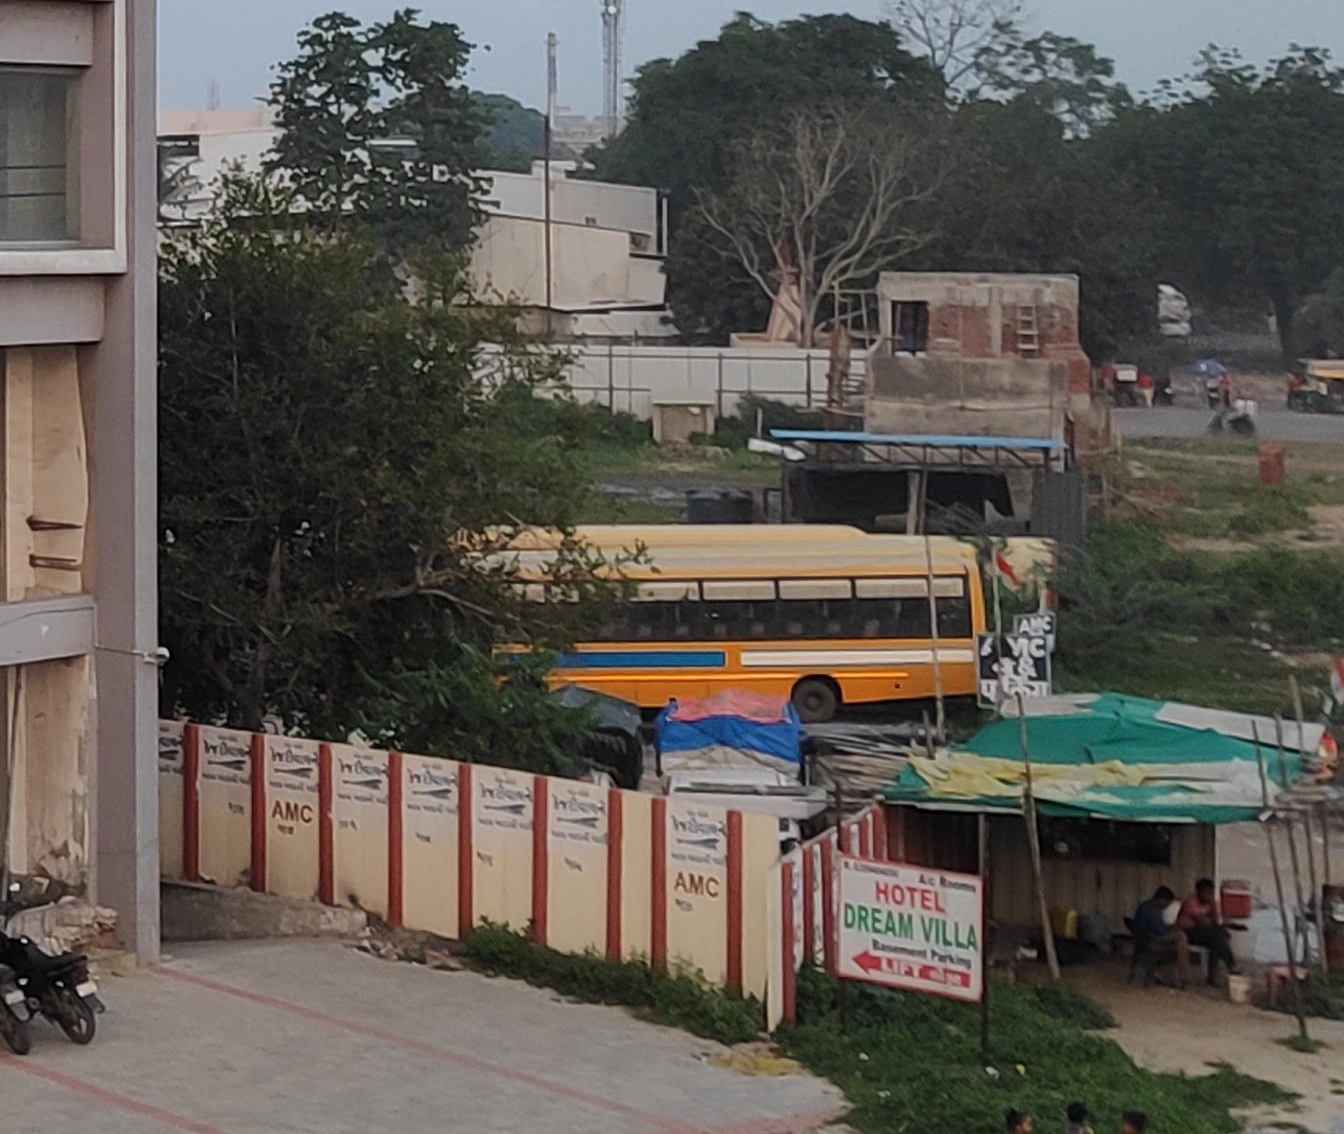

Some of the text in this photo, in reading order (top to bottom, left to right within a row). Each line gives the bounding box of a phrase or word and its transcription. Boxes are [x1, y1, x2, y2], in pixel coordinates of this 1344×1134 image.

[271, 800, 314, 823] AMC
[673, 871, 720, 898] AMC
[875, 880, 945, 913] HOTEL
[844, 902, 978, 952] DREAM VILLA
